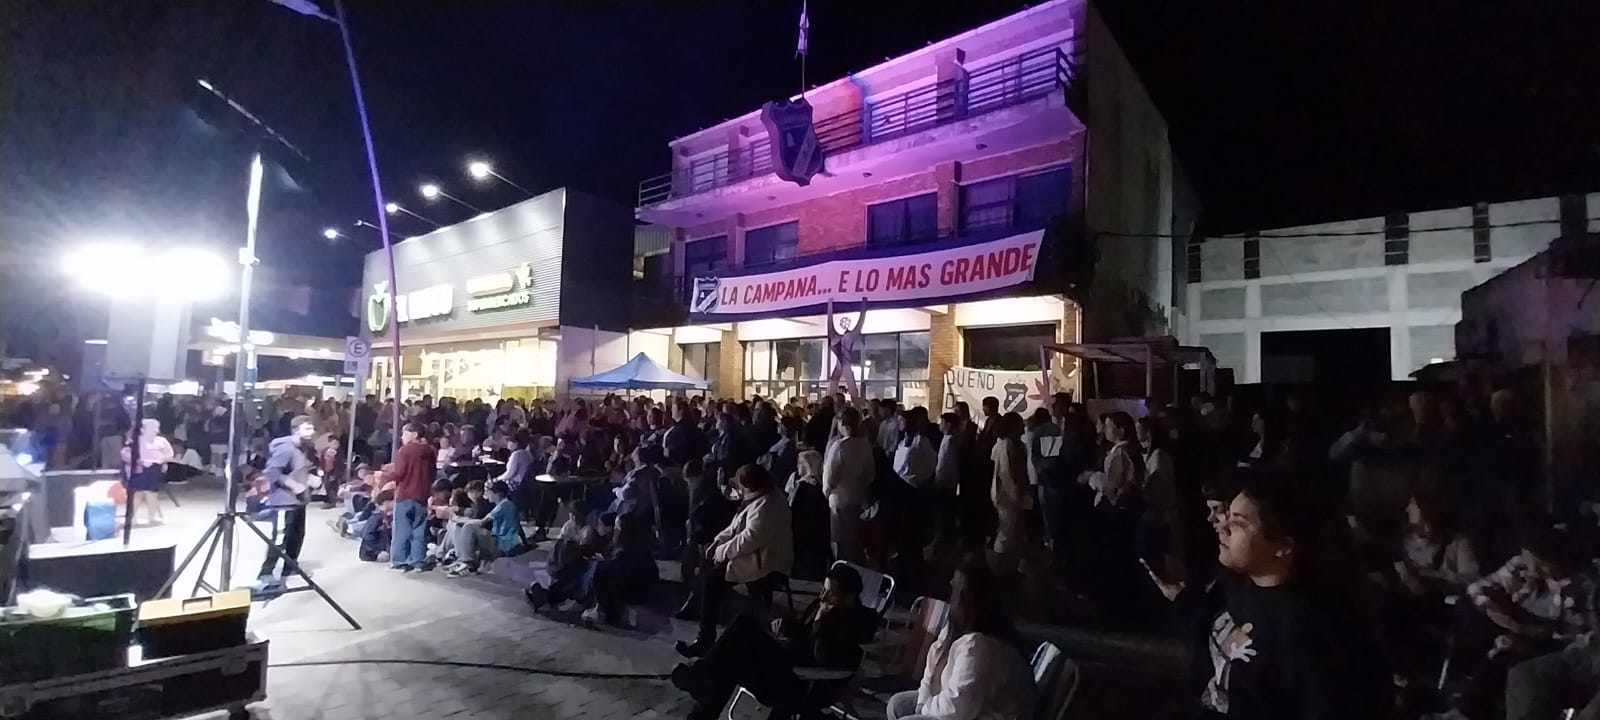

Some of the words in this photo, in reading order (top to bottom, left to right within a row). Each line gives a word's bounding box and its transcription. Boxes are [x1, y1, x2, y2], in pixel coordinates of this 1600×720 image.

[720, 286, 737, 306] LA
[743, 274, 832, 304] CAMPANA...
[838, 270, 850, 293] E
[855, 268, 879, 293] LO
[886, 263, 932, 291] MAS
[940, 242, 1036, 286] GRANDE
[354, 342, 363, 354] E
